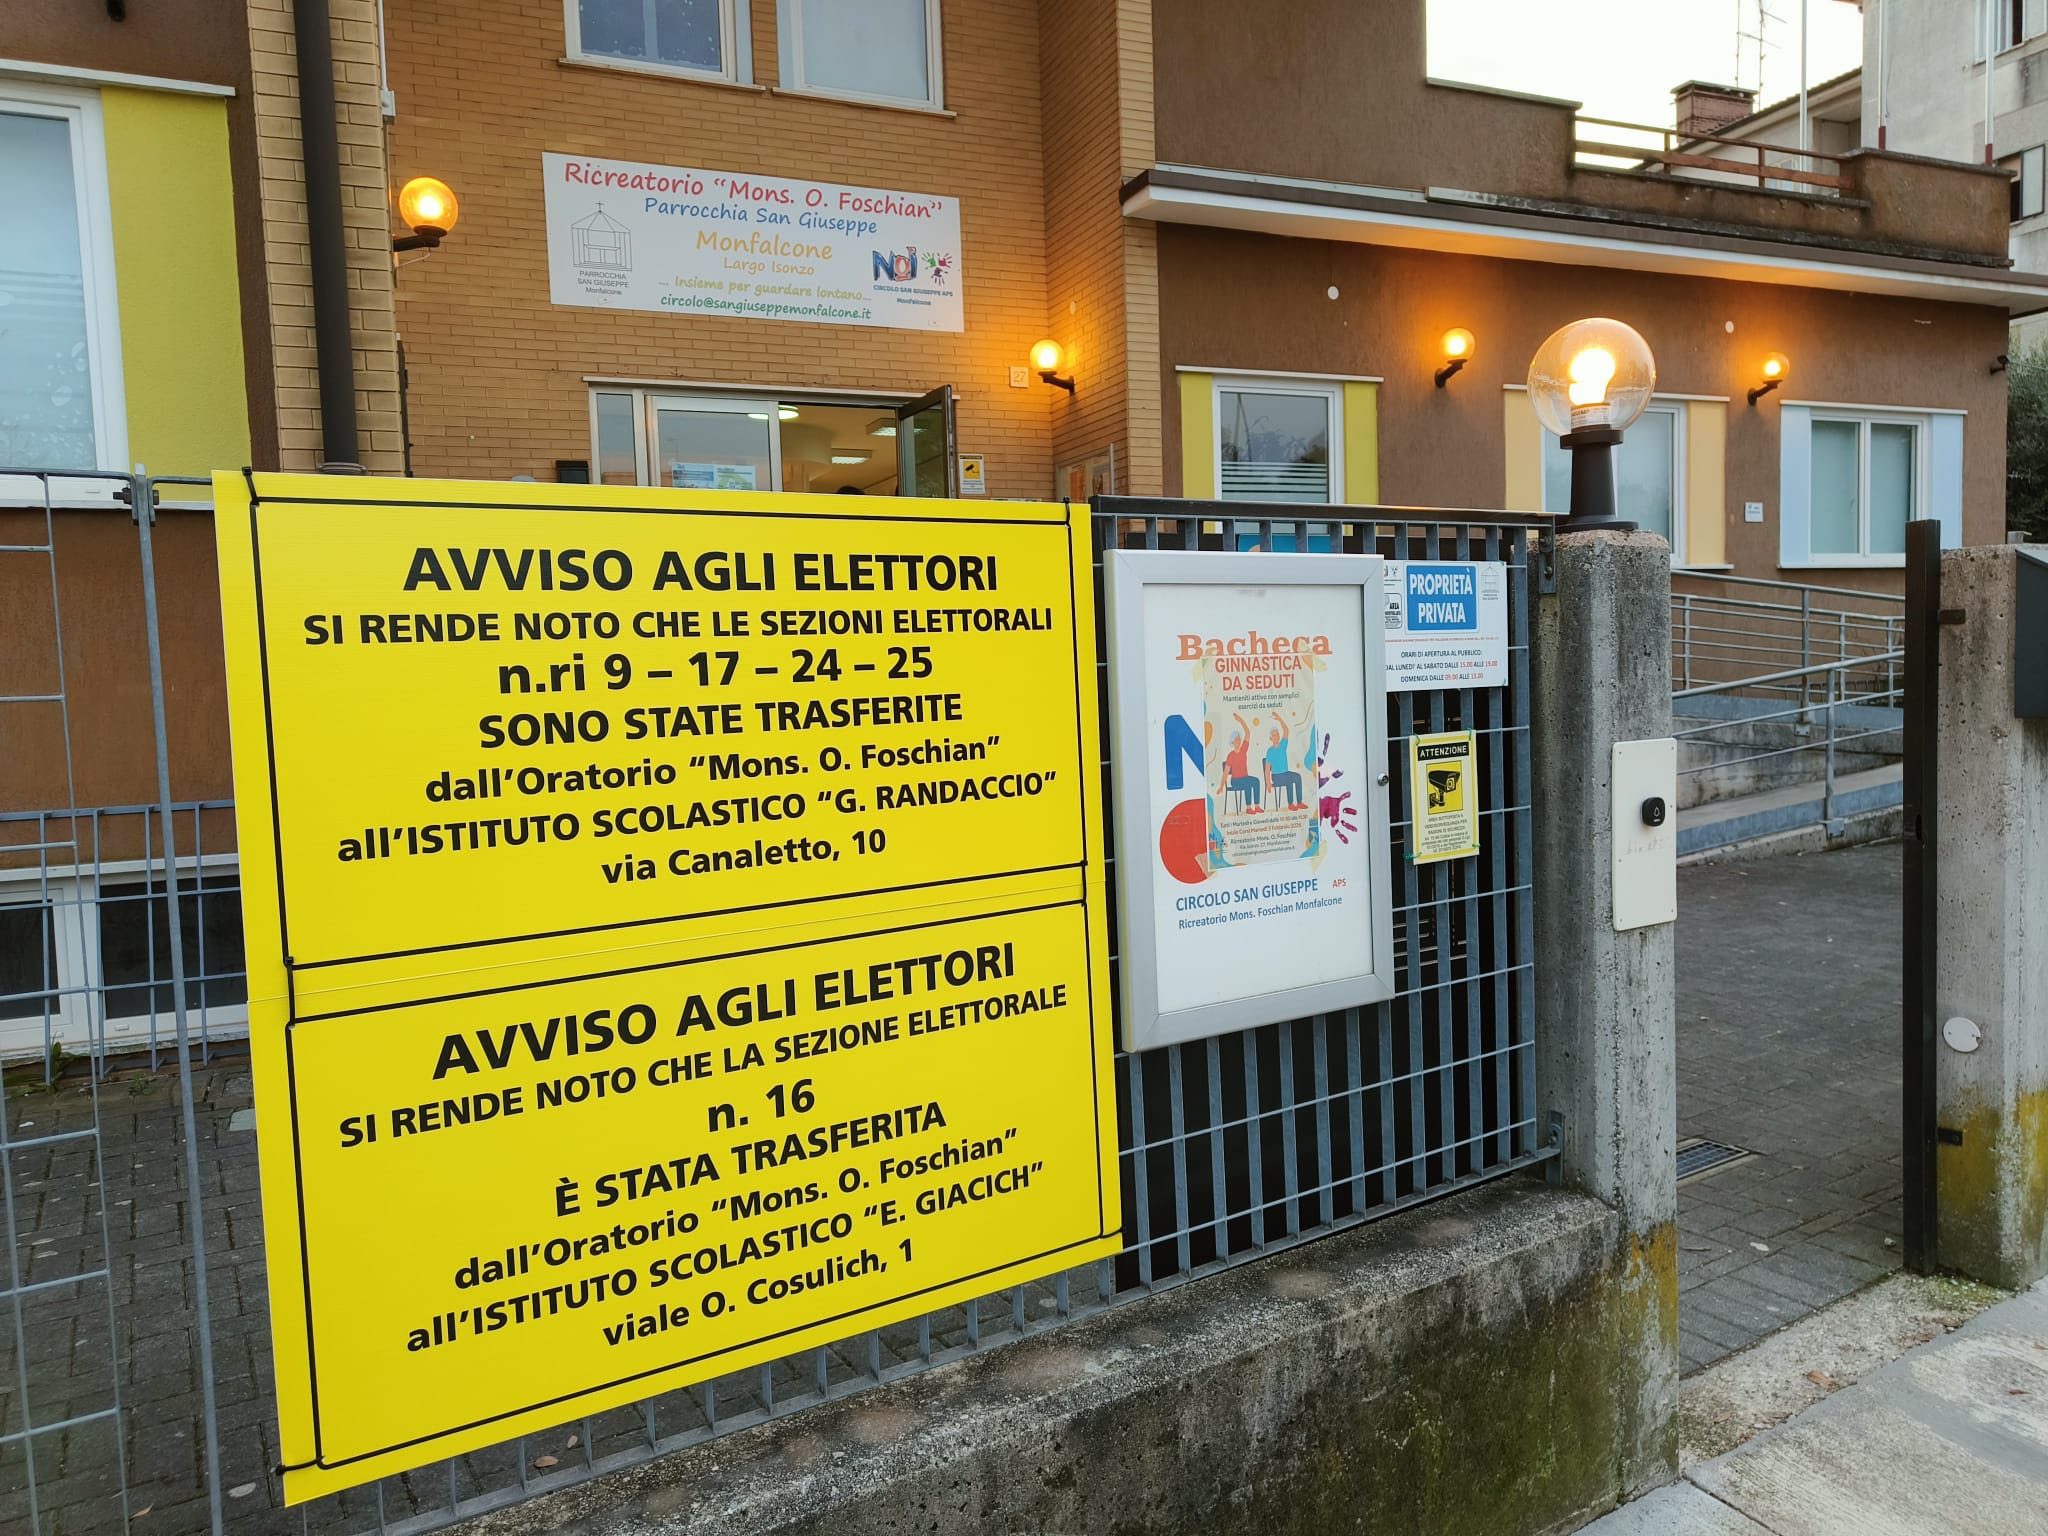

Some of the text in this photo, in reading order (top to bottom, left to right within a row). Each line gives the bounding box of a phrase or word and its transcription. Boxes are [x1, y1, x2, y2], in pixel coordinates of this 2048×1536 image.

[565, 162, 943, 218] Ricreatorio “Mons. O. Foschian”
[645, 197, 878, 237] Parrocchia San Giuseppe
[696, 230, 833, 260] Monfalcone
[579, 270, 627, 279] PARROCCHIA
[723, 257, 815, 276] Largo Isonzo
[585, 286, 622, 295] Monfalcone
[593, 279, 629, 288] GIUSEPPE
[675, 275, 724, 290] Insieme
[728, 281, 751, 295] per
[754, 283, 812, 297] guardare
[873, 284, 899, 293] CIRCOLO
[913, 288, 941, 296] GIUSEPPE
[660, 293, 872, 320] circolo@sangiuseppemonfalcone.it
[896, 297, 931, 305] Monfalcone
[1013, 370, 1027, 383] 27
[403, 547, 997, 592] AVVISO AGLI ELETTORI
[1408, 567, 1473, 596] PROPRIETÀ
[303, 607, 1052, 645] SI RENDE NOTO CHE LE SEZIONI ELETTORALI
[1417, 602, 1467, 624] PRIVATA
[1176, 630, 1333, 661] Bacheca
[1424, 649, 1450, 657] APERTURA
[498, 652, 586, 694] n.ri
[604, 653, 632, 690] 9
[688, 651, 739, 687] 17
[791, 648, 842, 683] 24
[887, 646, 933, 679] 25
[1215, 655, 1302, 674] GINNASTICA
[1401, 675, 1428, 683] DOMENICA
[1222, 673, 1295, 692] DA SEDUTI
[1223, 693, 1251, 703] Mantieniti
[1251, 693, 1267, 701] attivo
[1238, 702, 1259, 710] esercizi
[1267, 701, 1283, 709] seduti
[479, 693, 963, 749] SONO STATE TRASFERITE
[1419, 744, 1468, 759] ATTENZIONE
[425, 735, 1000, 803] dall’Oratorio “Mons. O. Foschian”
[337, 771, 1056, 862] all’ISTITUTO SCOLASTICO “G. RANDACCIO”
[601, 828, 886, 884] via Canaletto, 10
[1176, 878, 1347, 912] CIRCOLO SAN GIUSEPPE APS
[1178, 896, 1343, 930] Ricreatorio Mons. Foschian Monfalcone
[432, 942, 1014, 1081] AVVISO AGLI ELETTORI
[339, 983, 1067, 1148] SI RENDE NOTO CHE LA SEZIONE ELETTORALE
[708, 1078, 815, 1133] n. 16
[555, 1101, 947, 1217] È STATA TRASFERITA
[454, 1127, 1017, 1290] dall’Oratorio “Mons. O. Foschian”
[407, 1160, 1043, 1352] all’ISTITUTO SCOLASTICO “E. GIACICH”
[602, 1238, 912, 1346] viale O. Cosulich, 1
